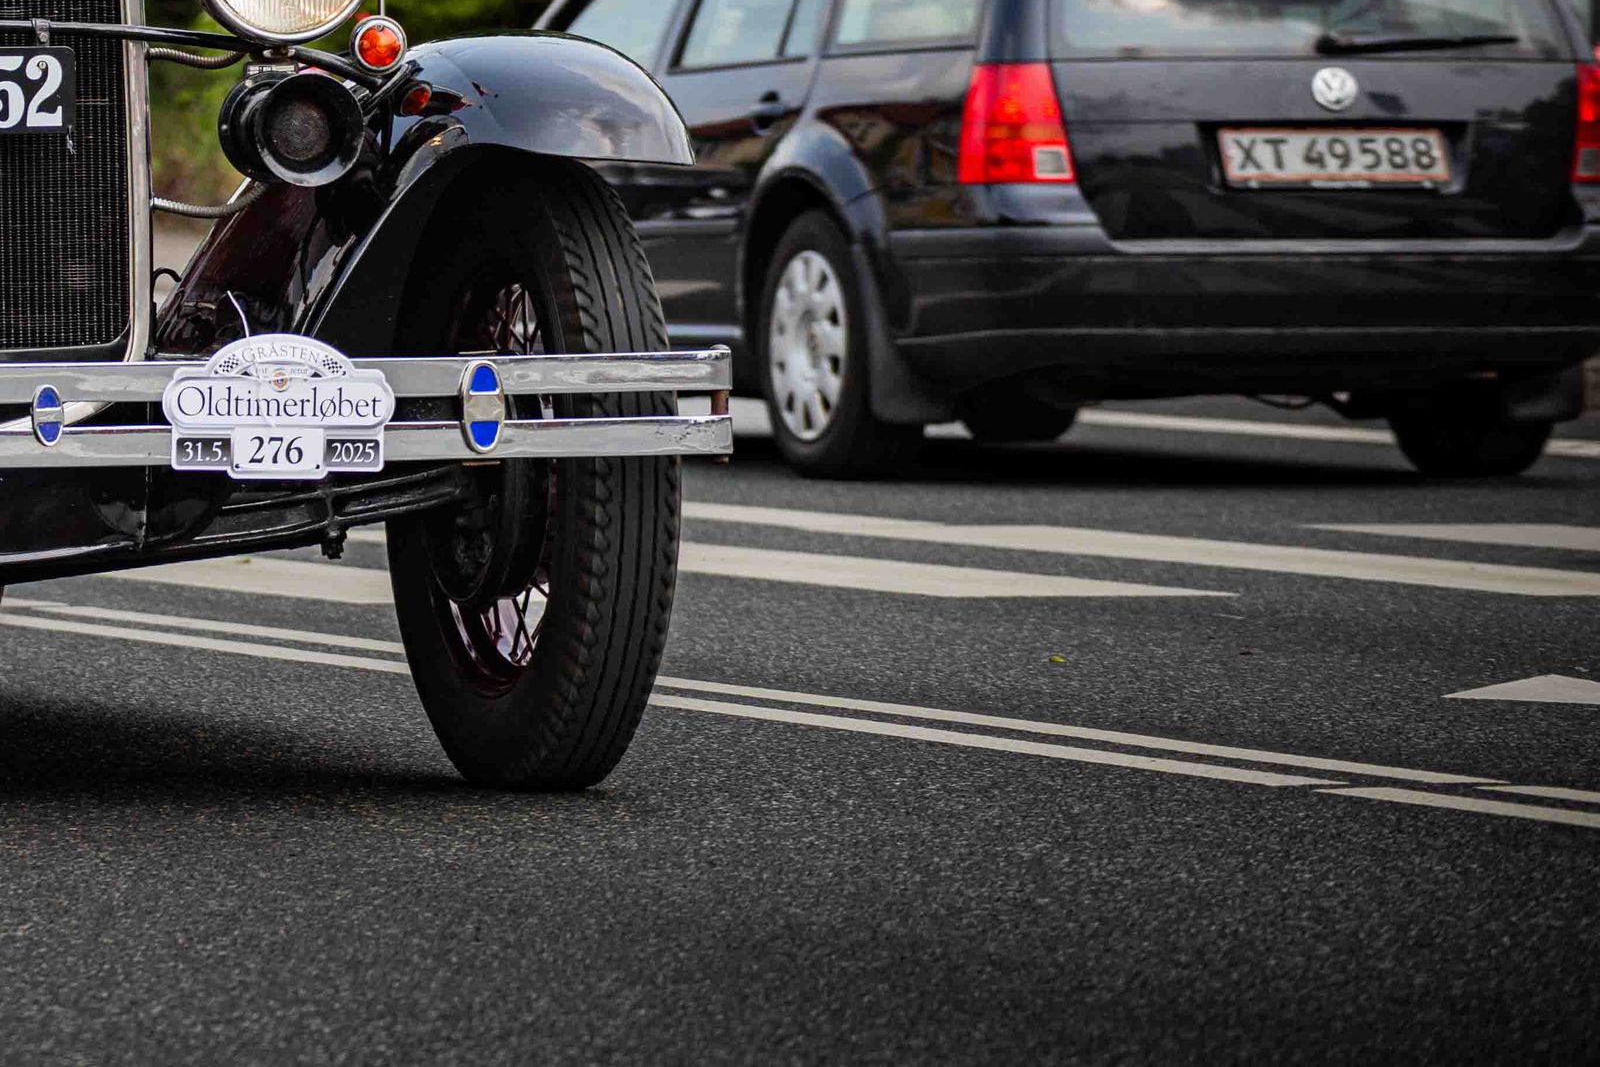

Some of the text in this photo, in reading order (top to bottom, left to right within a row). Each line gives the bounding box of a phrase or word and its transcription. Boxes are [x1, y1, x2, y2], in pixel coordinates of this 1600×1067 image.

[1233, 137, 1289, 171] XT
[241, 341, 320, 364] GRÅSTEN
[176, 385, 383, 422] Oldtimerløbet
[181, 441, 228, 463] 31.5.
[248, 435, 304, 465] 276
[331, 441, 375, 463] 2025
